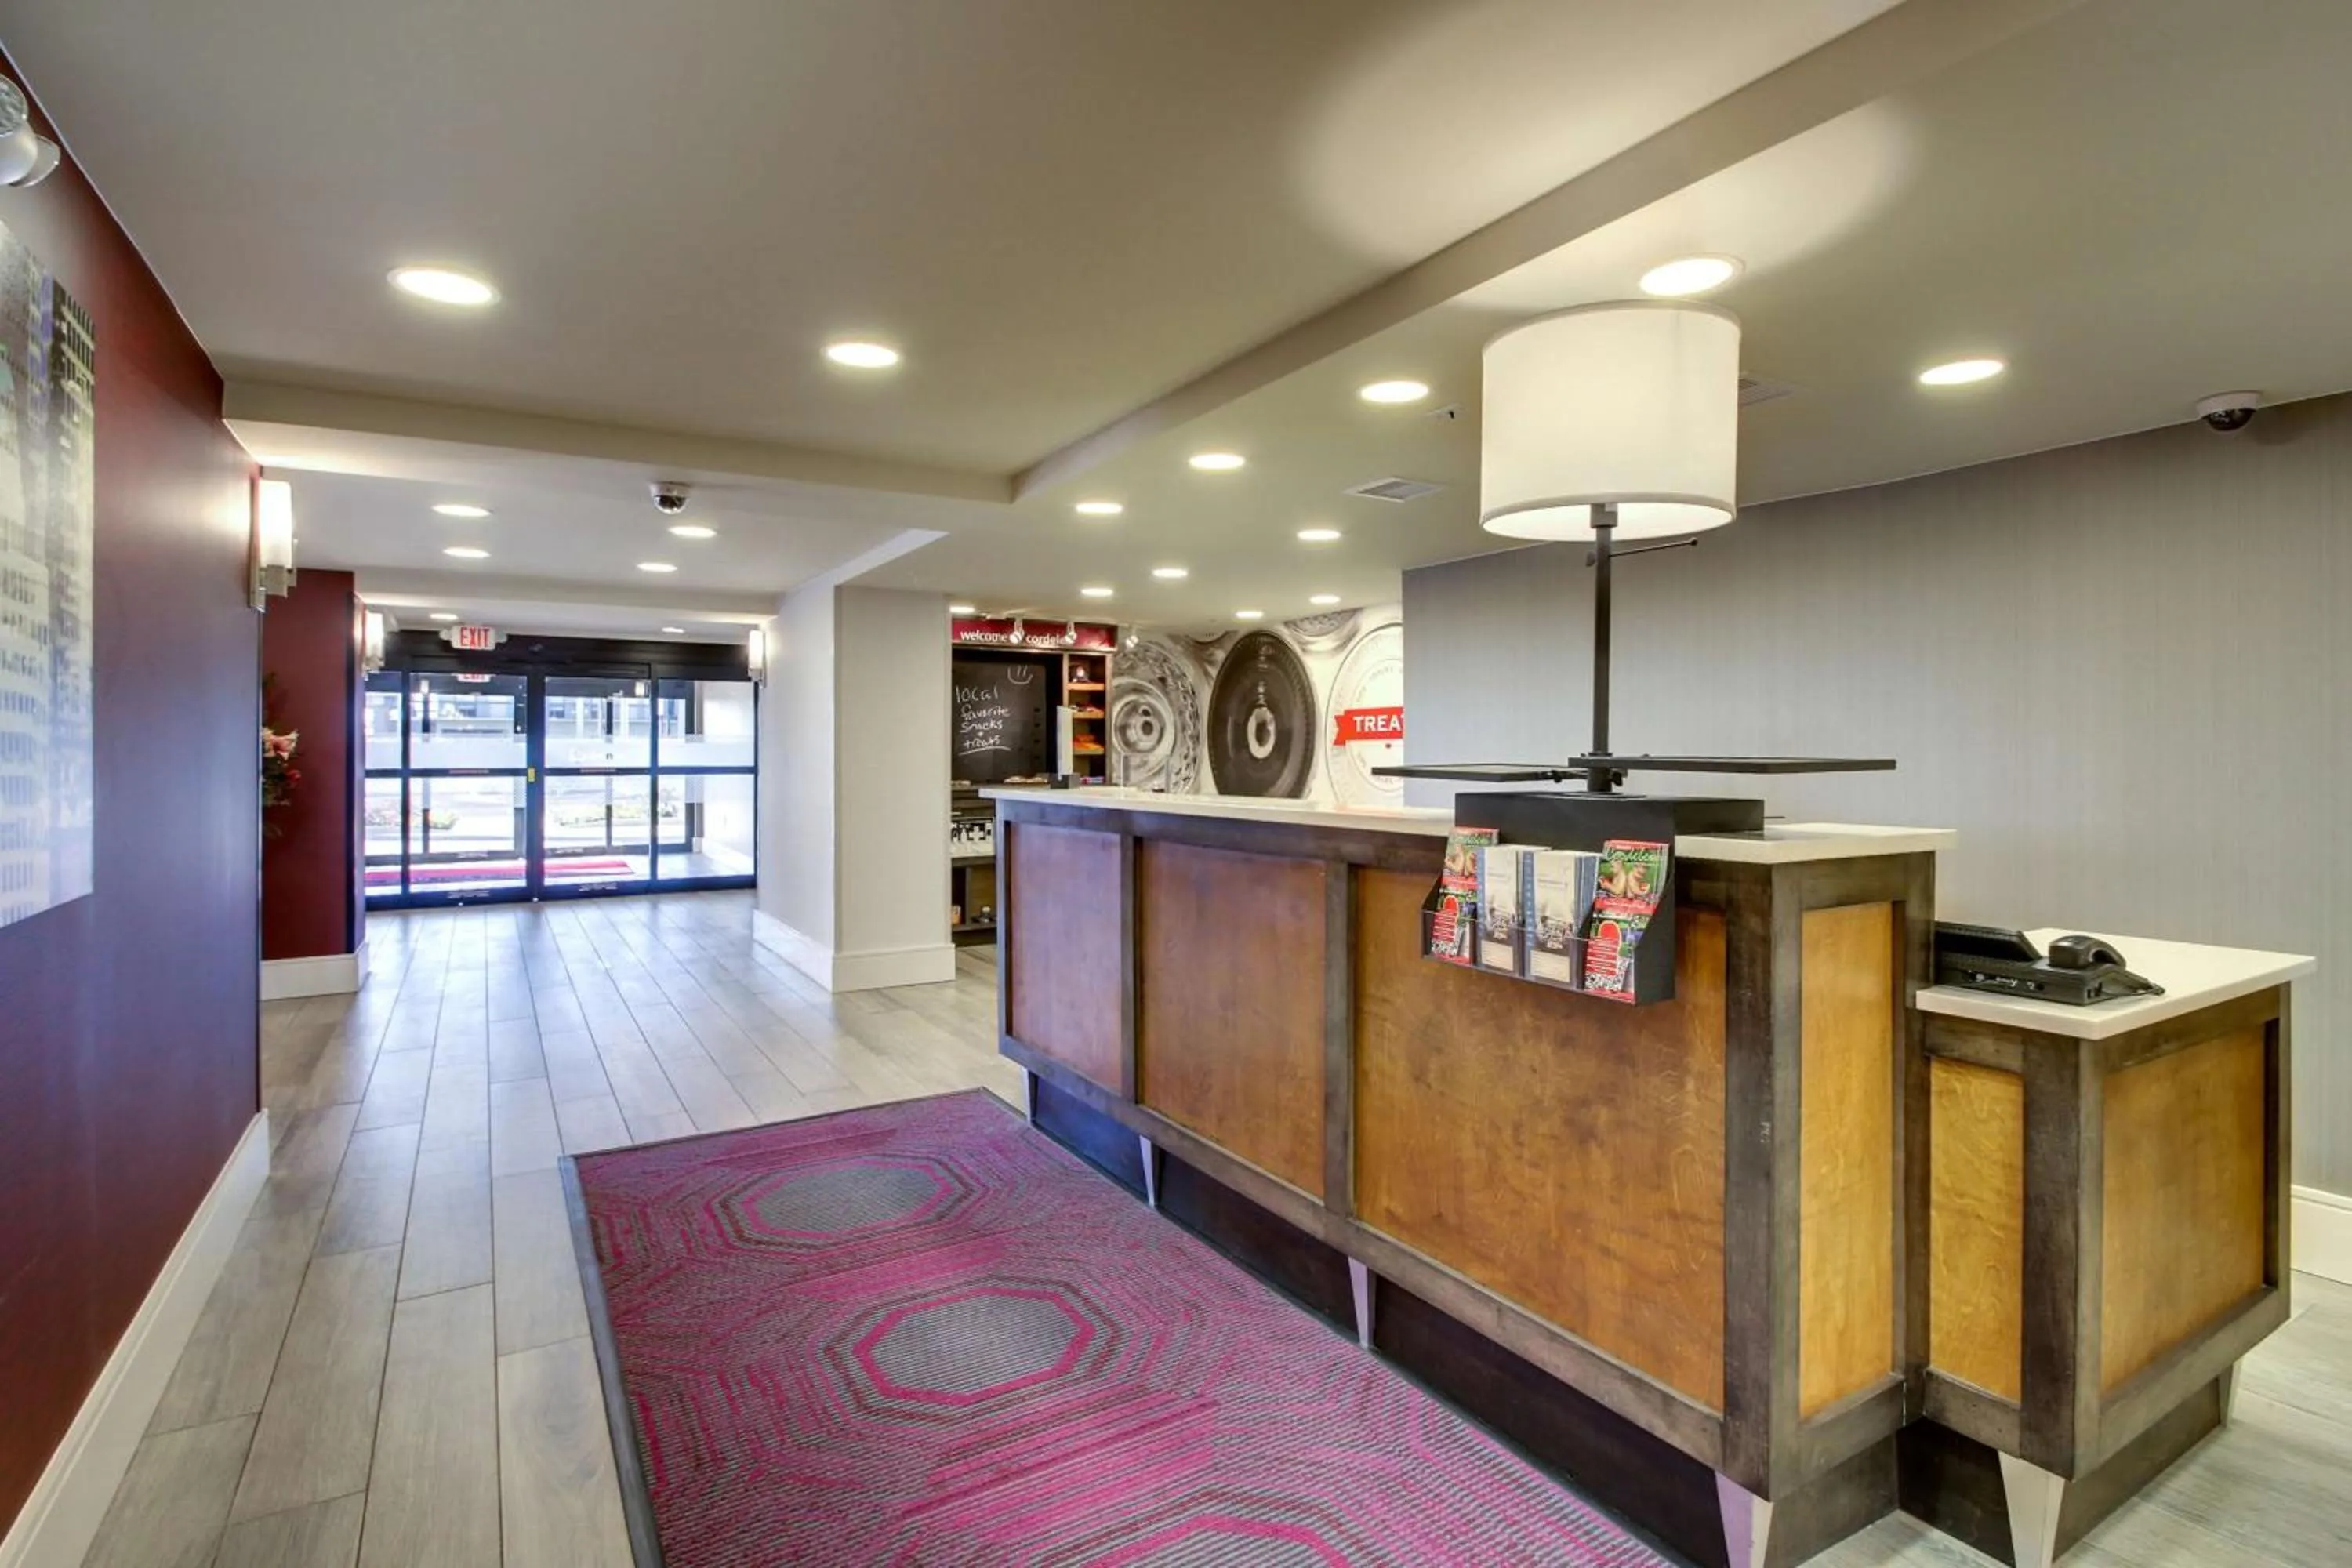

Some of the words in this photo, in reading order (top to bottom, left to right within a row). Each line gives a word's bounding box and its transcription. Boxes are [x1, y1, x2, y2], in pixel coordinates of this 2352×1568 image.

[459, 626, 491, 648] EXIT
[960, 630, 1008, 642] welcome
[955, 684, 998, 703] local
[960, 704, 1011, 720] favorite
[1353, 714, 1403, 732] TREA
[964, 735, 1001, 749] treats
